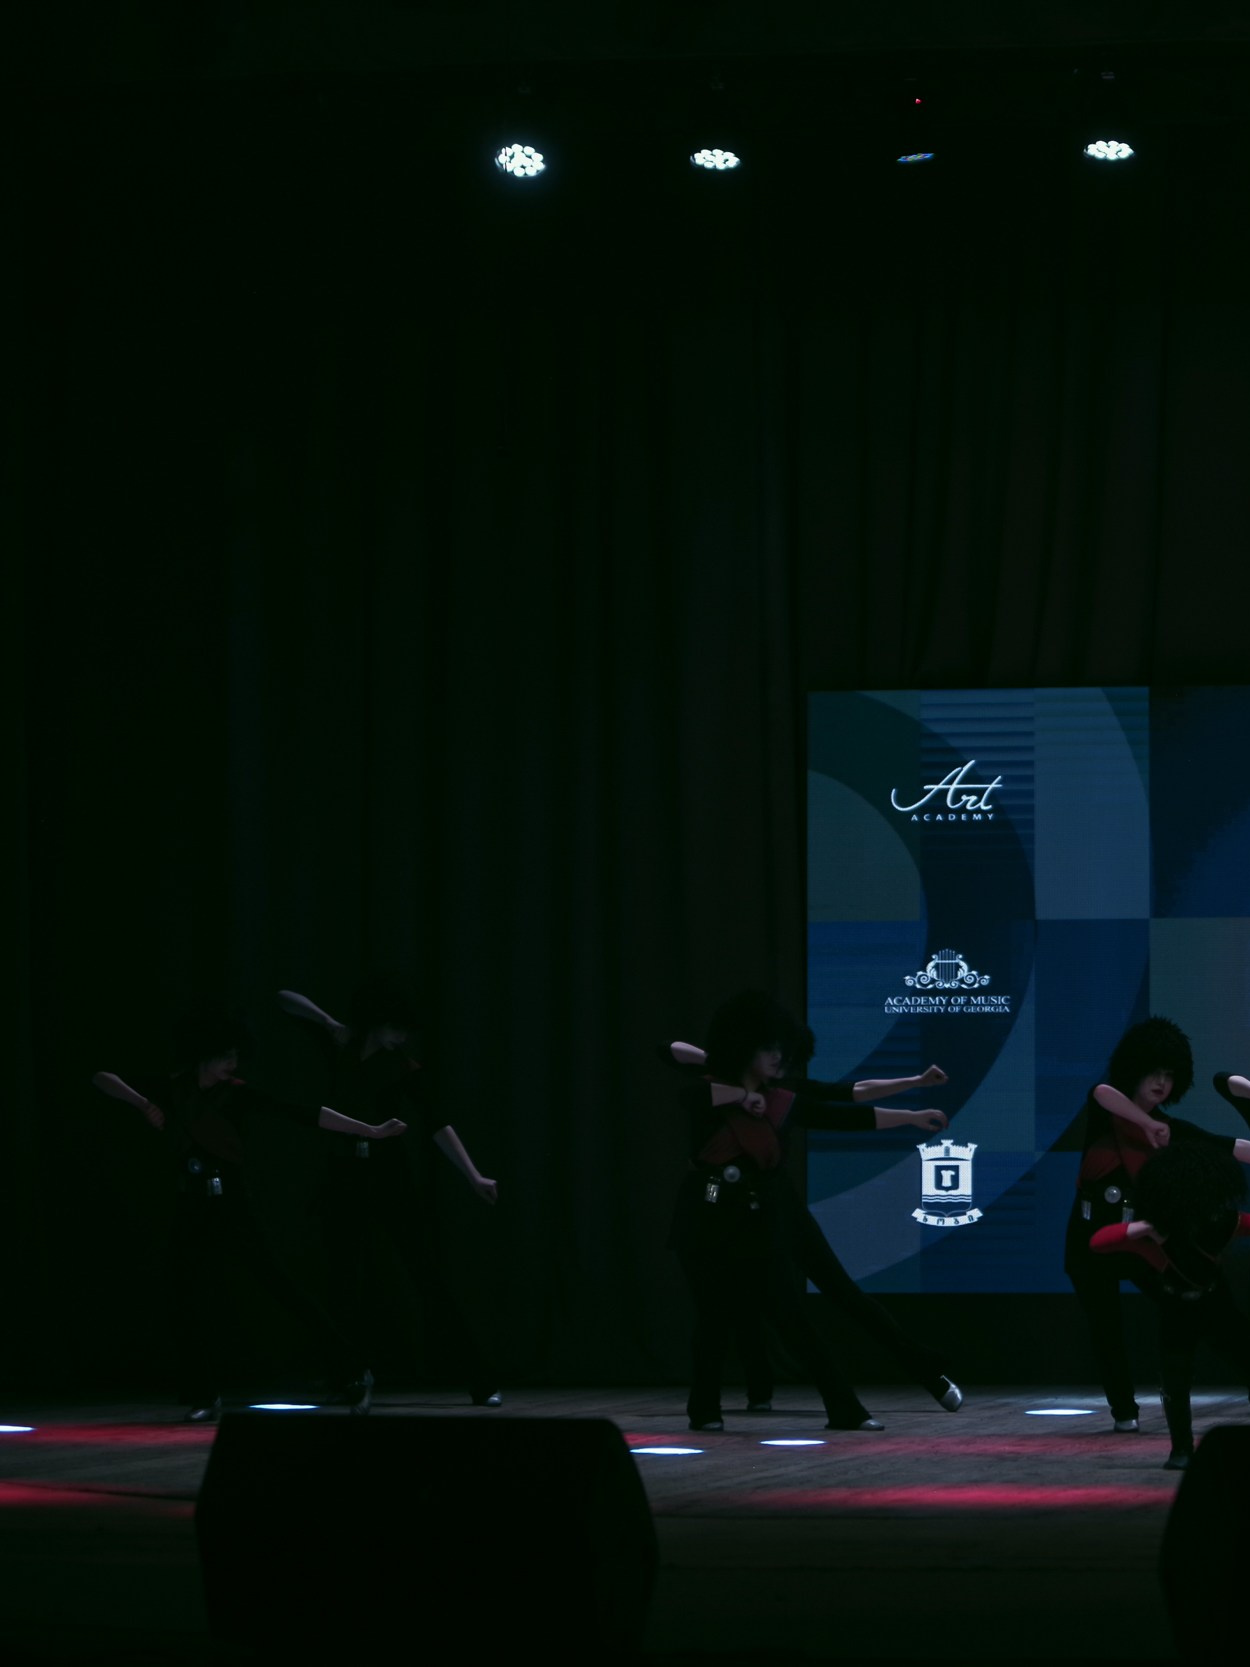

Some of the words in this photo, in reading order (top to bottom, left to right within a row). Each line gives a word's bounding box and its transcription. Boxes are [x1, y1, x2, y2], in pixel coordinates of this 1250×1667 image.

[890, 759, 1003, 812] Art
[911, 813, 995, 821] ACADEMY
[884, 996, 948, 1005] ACADEMY
[950, 996, 968, 1005] OF
[970, 996, 1010, 1005] MUSIC
[884, 1005, 945, 1014] UNIVERSITY
[947, 1005, 961, 1013] OF
[963, 1005, 1010, 1013] GEORGIA
